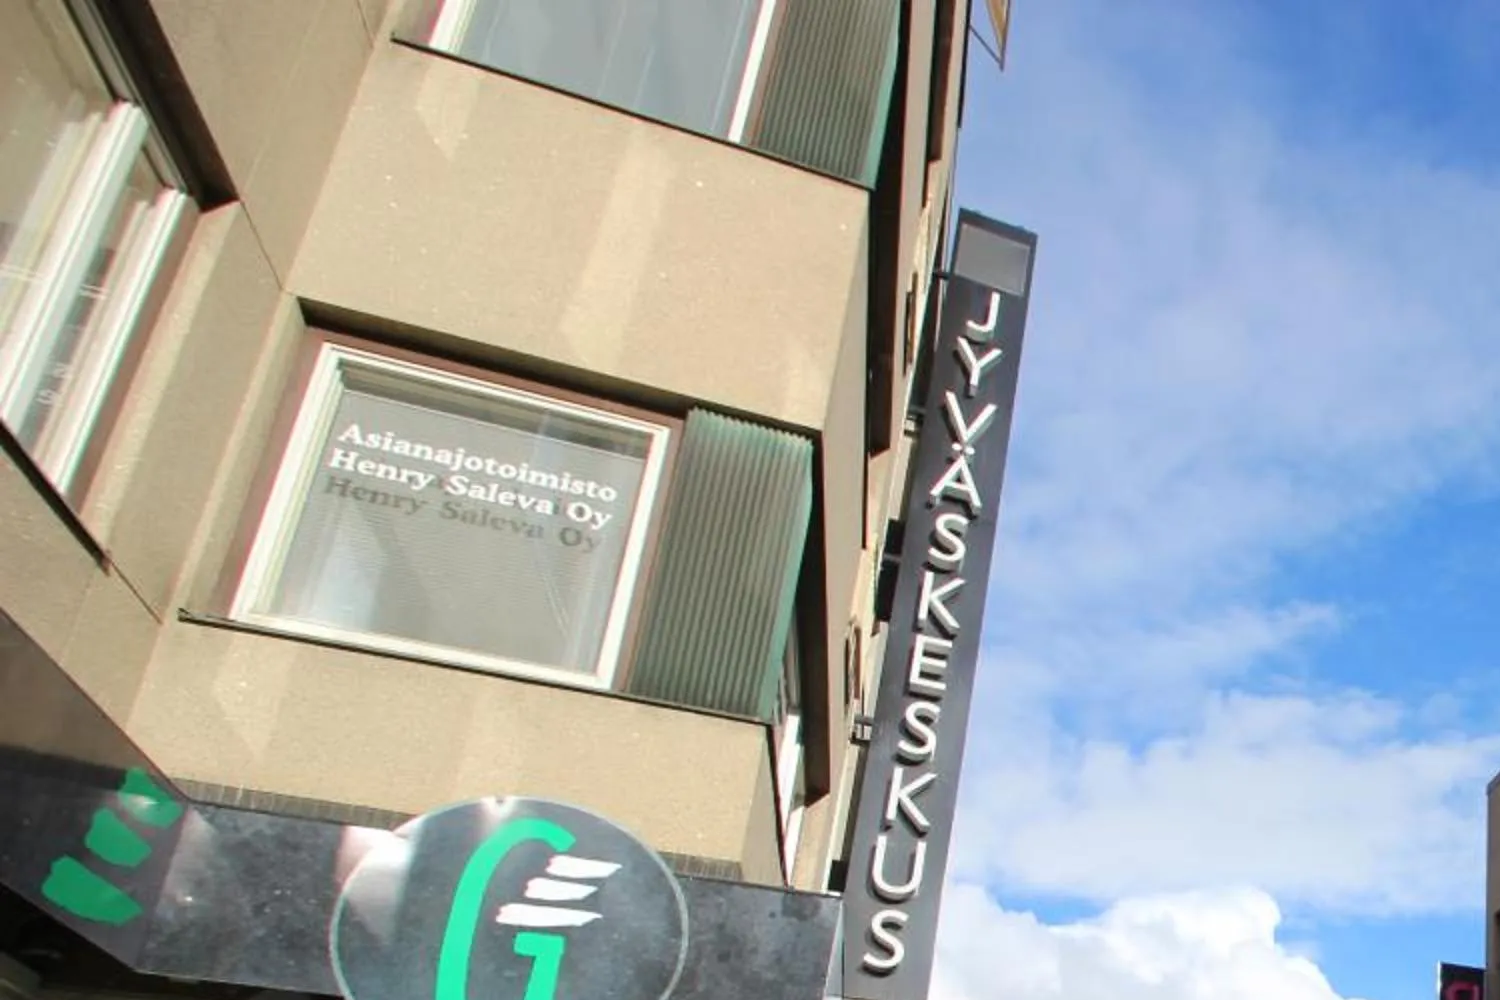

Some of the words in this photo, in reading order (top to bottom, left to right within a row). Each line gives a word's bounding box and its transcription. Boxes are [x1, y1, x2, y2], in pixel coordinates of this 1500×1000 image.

[329, 448, 434, 490] Henry
[445, 474, 553, 516] Saleva
[566, 501, 613, 530] Oy
[337, 423, 618, 502] Asianajotoimisto
[863, 291, 1003, 973] JYVÄSKESKUS
